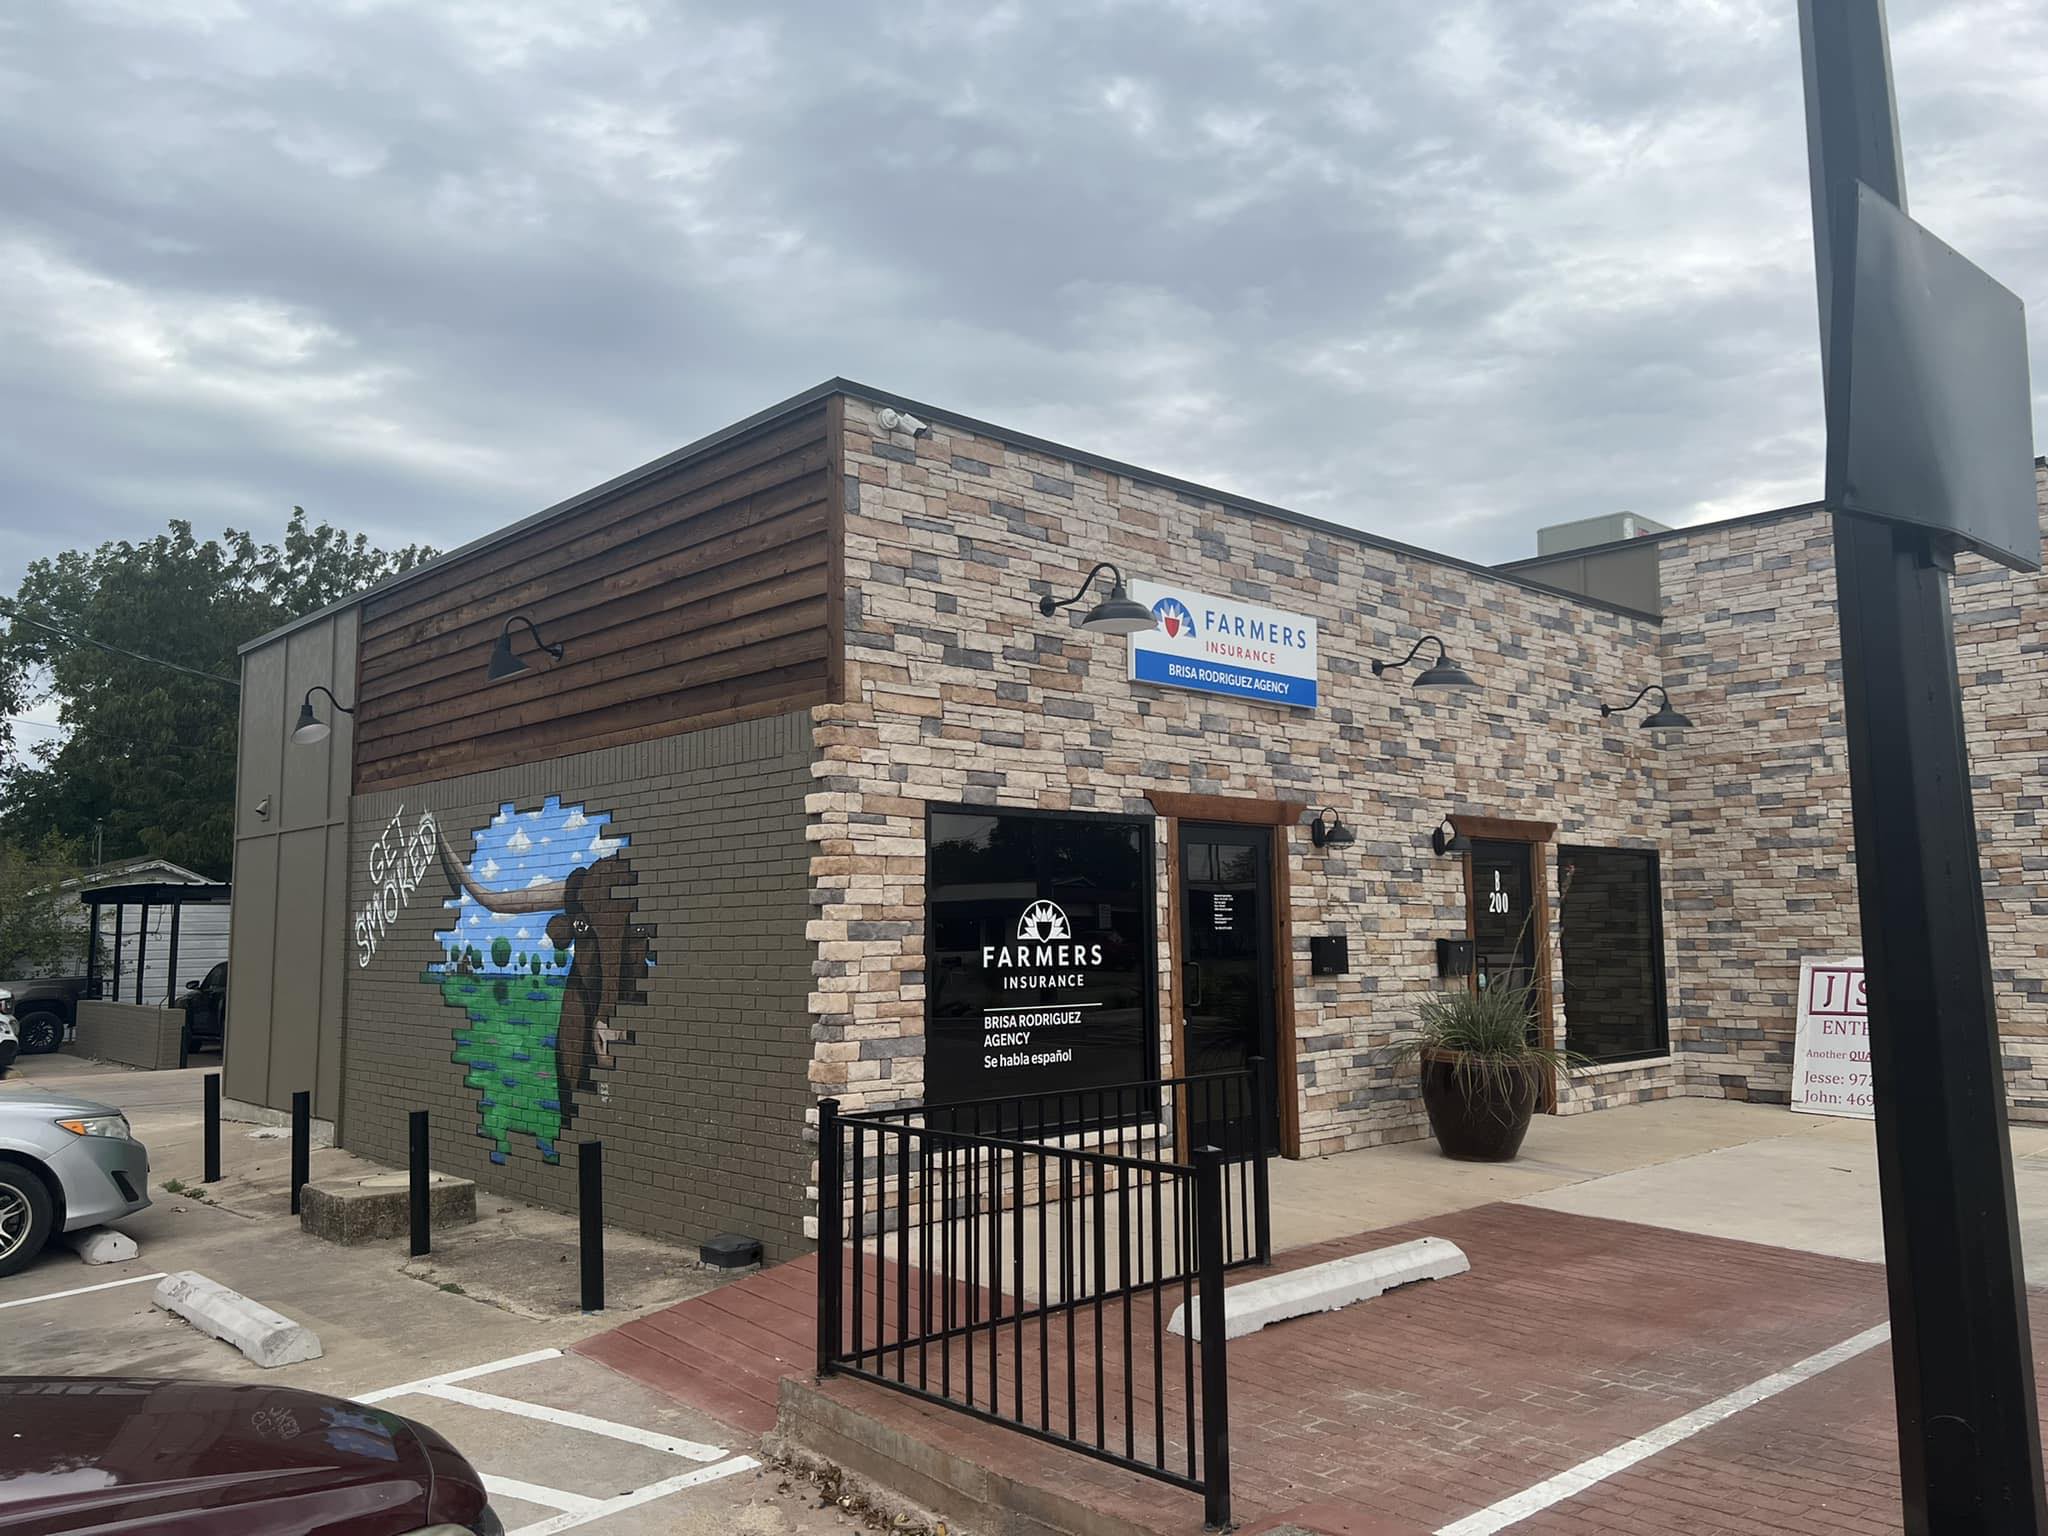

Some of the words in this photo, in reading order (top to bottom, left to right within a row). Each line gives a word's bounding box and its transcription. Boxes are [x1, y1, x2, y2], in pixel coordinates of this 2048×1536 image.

[1206, 611, 1306, 648] FARMERS
[1206, 641, 1276, 664] INSURANCE
[1169, 664, 1197, 679] BRISA
[1199, 669, 1252, 688] RODRIGUEZ
[1254, 679, 1290, 695] AGENCY
[370, 804, 405, 884] GET
[355, 811, 436, 968] SMOKED
[1489, 892, 1509, 913] 200
[982, 944, 1103, 968] FARMERS
[1003, 974, 1085, 990] INSURANCE
[984, 1014, 1017, 1030] BRISA
[1018, 1011, 1081, 1027] RODRIGUEZ
[984, 1032, 1030, 1048] AGENCY
[984, 1054, 998, 1069] Se
[999, 1051, 1030, 1067] habla
[1031, 1048, 1072, 1066] español
[1806, 1049, 1847, 1060] Another
[1804, 1071, 1844, 1085] Jesse:
[1804, 1090, 1842, 1105] John:
